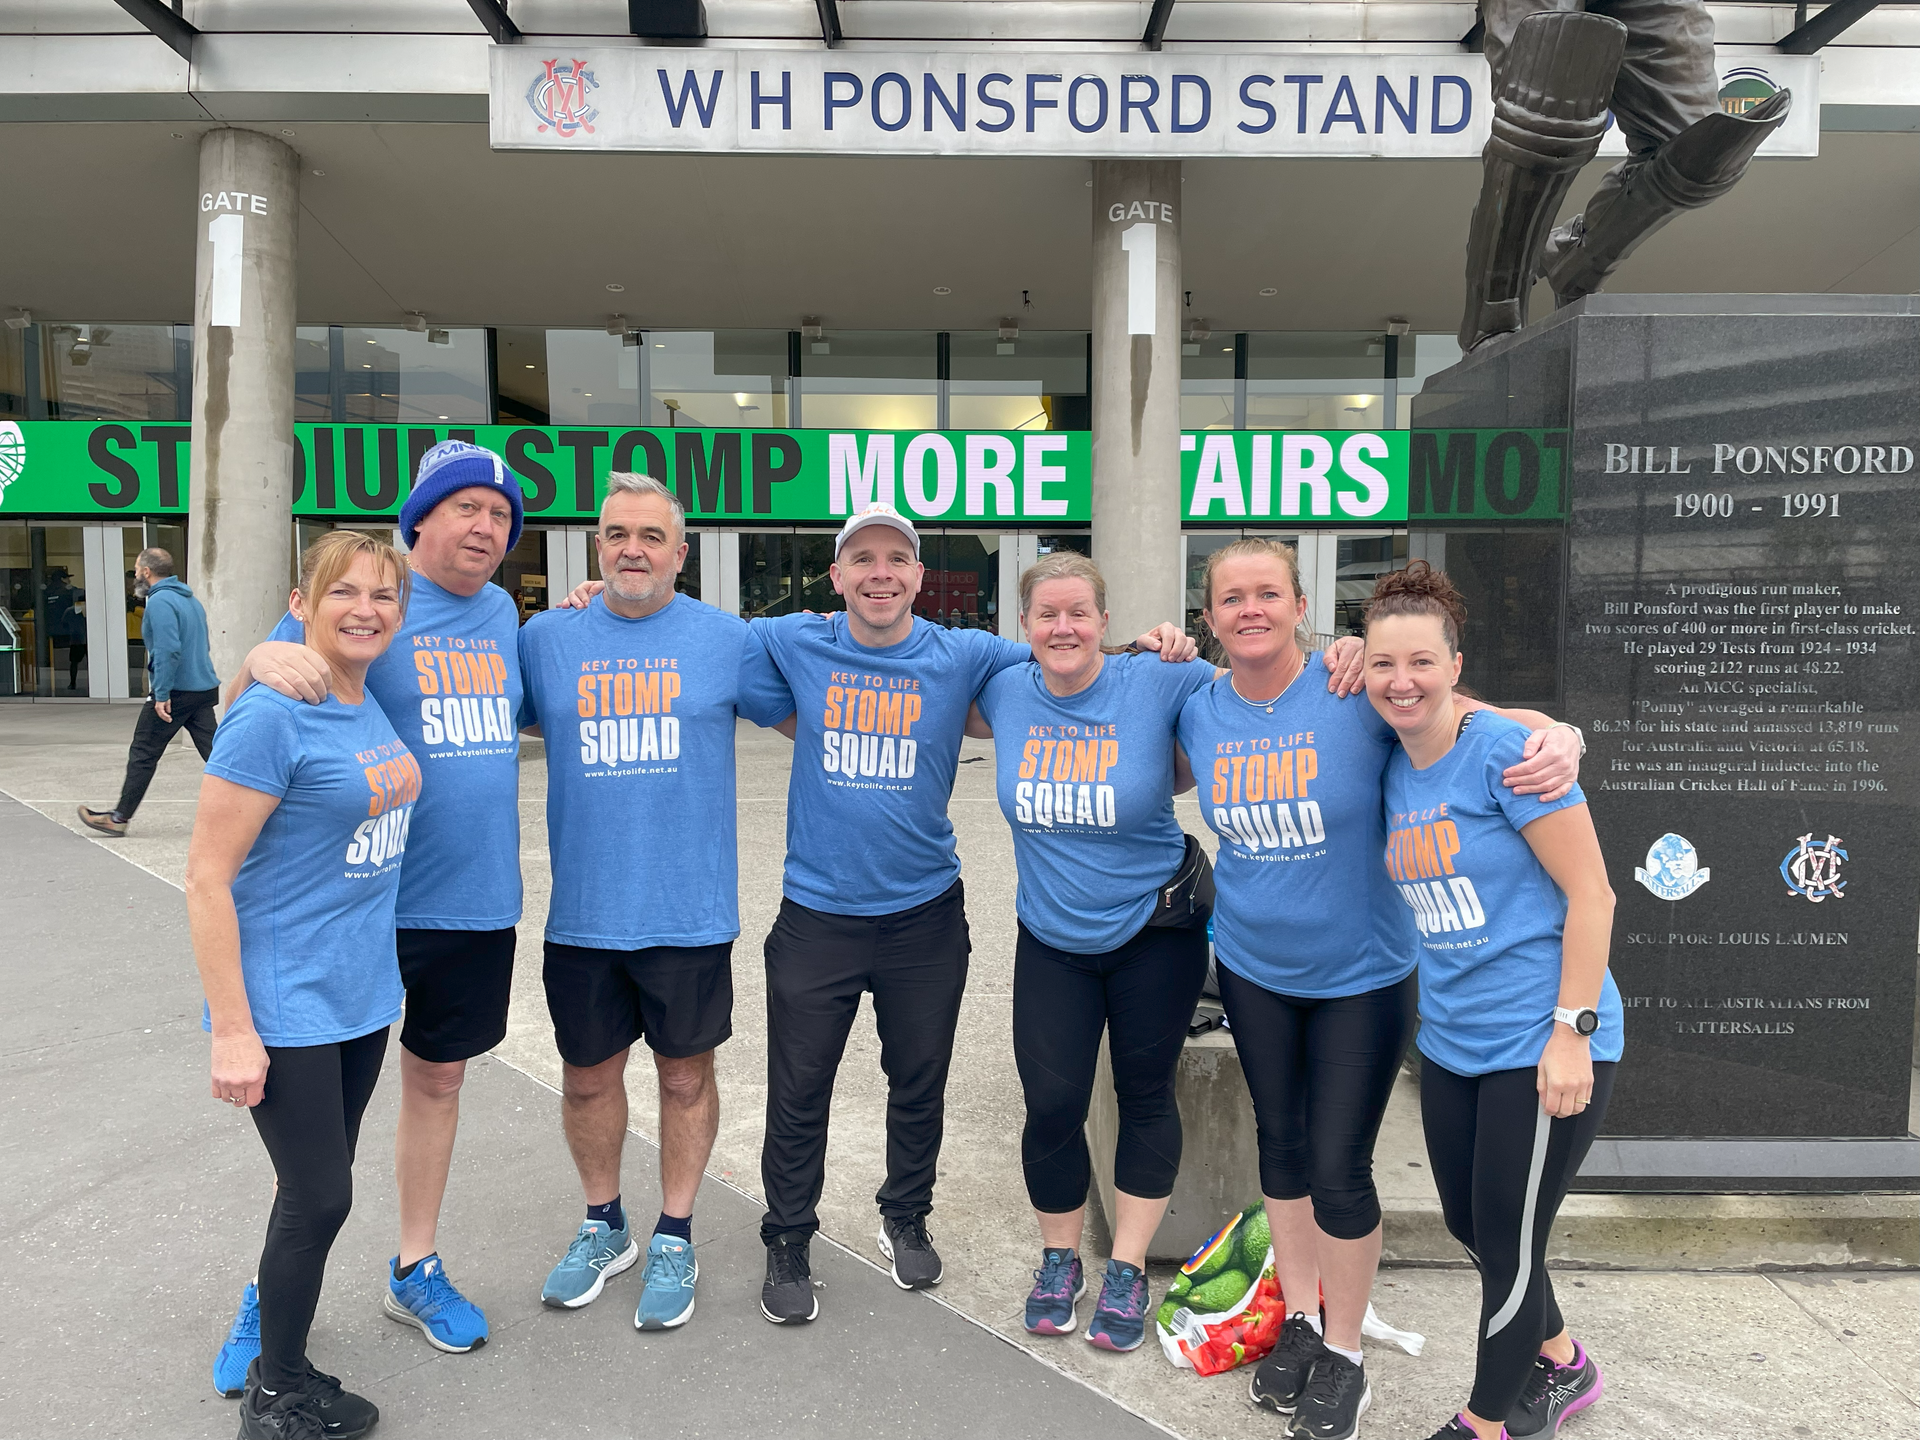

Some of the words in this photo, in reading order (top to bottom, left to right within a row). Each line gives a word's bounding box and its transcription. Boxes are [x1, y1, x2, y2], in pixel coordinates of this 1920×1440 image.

[656, 69, 724, 129] W
[750, 71, 791, 131] H
[824, 71, 1210, 135] PONSFORD
[1237, 73, 1473, 135] STAND
[200, 191, 268, 216] GATE
[1108, 200, 1173, 224] GATE
[208, 214, 244, 327] 1
[1121, 223, 1157, 335] 1
[1604, 443, 1691, 474] BILL
[1712, 443, 1914, 474] PONSFORD
[87, 424, 475, 512] STIU
[505, 429, 802, 515] STOMP
[828, 433, 1069, 517] MORE
[1180, 432, 1389, 518] AIRS
[1673, 493, 1734, 518] 1900
[1781, 493, 1841, 518] 1991
[1665, 583, 1676, 595] A
[1682, 583, 1757, 599] prodigious
[1762, 586, 1787, 595] run
[1792, 583, 1841, 597] maker,
[1604, 602, 1628, 615] Bill
[1634, 602, 1698, 615] Ponsford
[1703, 605, 1729, 615] was
[1733, 602, 1756, 615] the
[1760, 602, 1790, 615] first
[1794, 602, 1840, 619] player
[1844, 604, 1857, 615] to
[1862, 602, 1900, 615] make
[1585, 624, 1611, 635] two
[1615, 625, 1658, 635] scores
[1663, 622, 1679, 635] of
[1681, 622, 1706, 635] 400
[1711, 626, 1727, 635] or
[1731, 626, 1768, 635] more
[1771, 622, 1786, 635] in
[1790, 622, 1859, 635] first-class
[1863, 622, 1915, 635] cricket.
[413, 635, 441, 648] KEY
[447, 637, 465, 649] TO
[471, 639, 498, 651] LIFE
[1624, 642, 1644, 654] He
[1648, 642, 1695, 657] played
[1699, 642, 1716, 654] 29
[1720, 642, 1755, 654] Tests
[1760, 642, 1794, 654] from
[1800, 642, 1831, 654] 1924
[1846, 642, 1877, 654] 1934
[414, 650, 508, 695] STOMP
[581, 660, 609, 672] KEY
[617, 659, 638, 670] TO
[644, 658, 678, 669] LIFE
[1653, 662, 1706, 677] scoring
[1710, 662, 1743, 674] 2122
[1748, 665, 1781, 674] runs
[1784, 663, 1798, 674] at
[831, 671, 858, 686] KEY
[864, 675, 883, 688] TO
[889, 677, 920, 691] LIFE
[1679, 682, 1699, 694] An
[577, 671, 681, 718] STOMP
[824, 685, 922, 737] STOMP
[1699, 701, 1763, 717] averaged
[1768, 705, 1776, 713] a
[1781, 701, 1863, 713] remarkable
[421, 697, 513, 747] SQUAD
[1028, 725, 1053, 737] KEY
[1059, 726, 1078, 737] TO
[1085, 724, 1116, 737] LIFE
[1635, 720, 1656, 733] for
[1660, 720, 1680, 733] his
[1685, 720, 1718, 733] state
[1722, 720, 1748, 733] and
[1753, 720, 1813, 733] amassed
[1868, 723, 1899, 733] runs
[579, 716, 680, 768] SQUAD
[1216, 741, 1244, 754] KEY
[1250, 737, 1271, 751] TO
[1278, 731, 1315, 748] LIFE
[1623, 740, 1644, 752] for
[1647, 740, 1712, 752] Australia
[1717, 740, 1743, 752] and
[1748, 740, 1804, 752] Victoria
[1810, 742, 1824, 752] at
[355, 749, 378, 765] KEY
[377, 744, 391, 757] TO
[823, 730, 917, 779] SQUAD
[1018, 739, 1119, 783] STOMP
[584, 766, 678, 778] www.keytolife.net.au
[1212, 748, 1318, 804] STOMP
[1611, 759, 1630, 772] He
[1636, 762, 1661, 772] was
[1666, 762, 1683, 772] an
[1688, 759, 1757, 774] inaugural
[1761, 759, 1820, 772] inductee
[1825, 759, 1852, 772] into
[1857, 759, 1879, 772] the
[827, 778, 913, 791] www.keytolife.net.au
[1599, 779, 1675, 791] Australian
[1679, 779, 1733, 791] Cricket
[1737, 779, 1766, 791] Hall
[1771, 779, 1788, 791] of
[1790, 779, 1829, 791] Fame
[1833, 779, 1847, 791] in
[1852, 779, 1888, 791] 1996.
[1015, 781, 1116, 828] SQUAD
[1421, 802, 1448, 821] LIE
[345, 806, 412, 867] SQUA
[1213, 800, 1326, 853] SQUAD
[1718, 933, 1770, 945] LOUIS
[1776, 933, 1848, 945] LAUMEN
[1658, 997, 1677, 1009] TO
[1717, 997, 1822, 1009] AUSTRALIANS
[1828, 997, 1870, 1009] FROM
